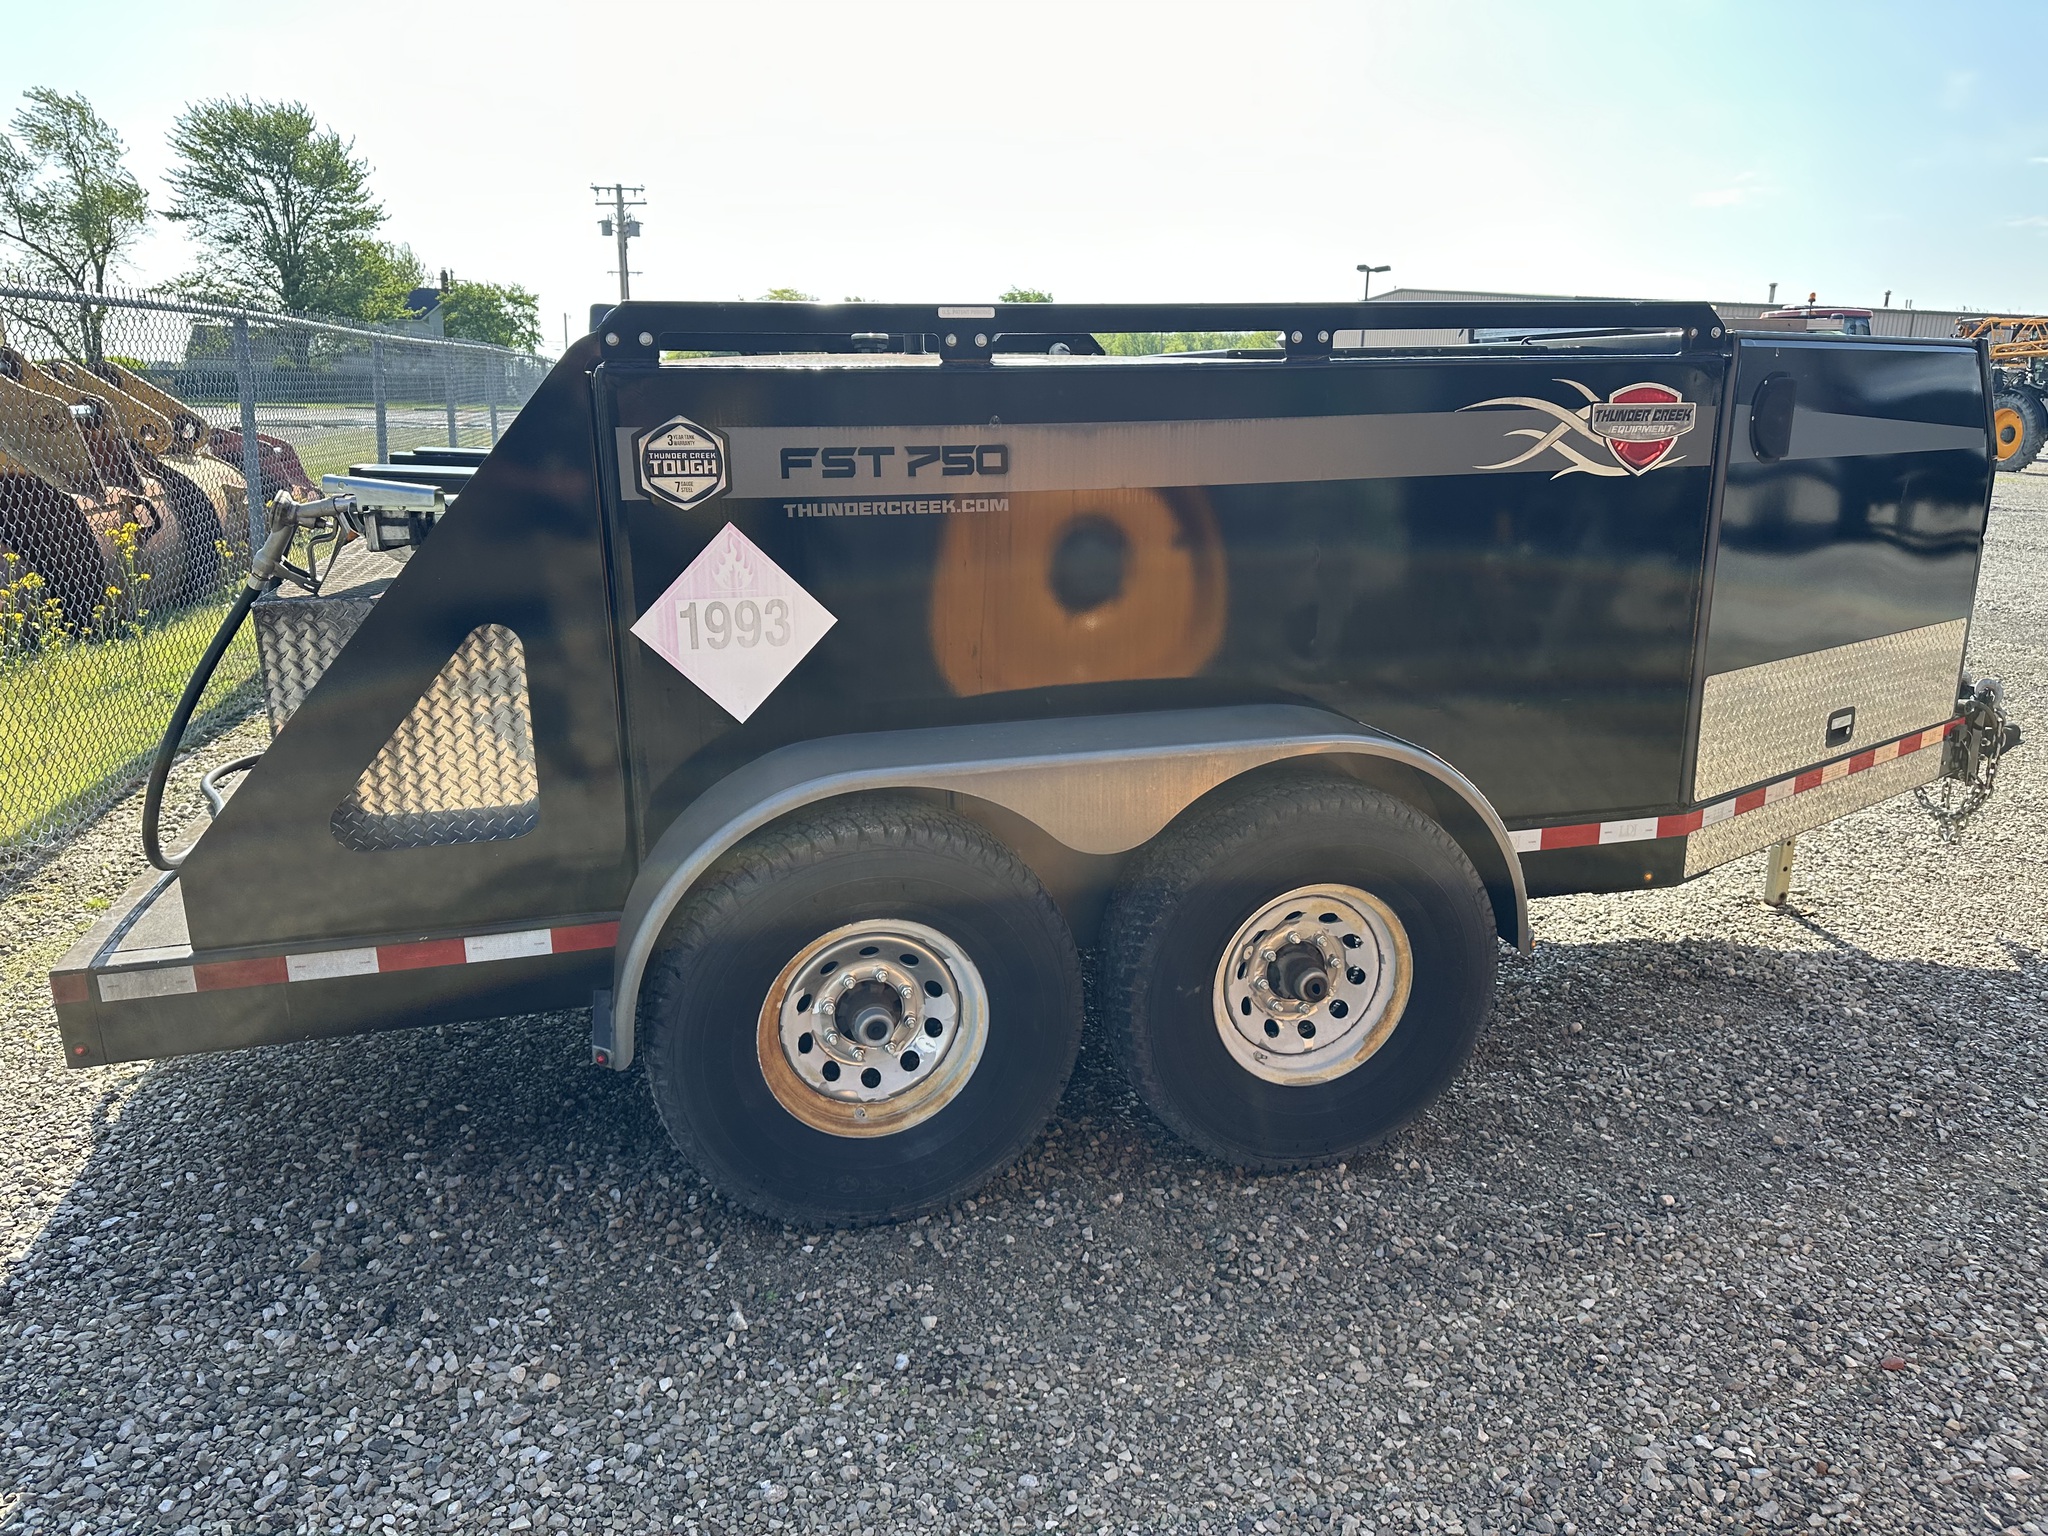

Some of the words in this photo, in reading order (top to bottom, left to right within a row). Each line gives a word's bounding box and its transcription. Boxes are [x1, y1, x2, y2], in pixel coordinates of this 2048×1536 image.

[1595, 409, 1653, 422] THUNDER
[1652, 408, 1693, 422] CREEK
[1610, 424, 1674, 434] EQUIPMENT
[667, 434, 674, 446] 3
[649, 459, 717, 475] TOUGH
[780, 446, 895, 479] FST
[904, 444, 1009, 477] 750
[674, 481, 680, 492] 7
[783, 498, 1009, 518] THUNDERCREEK.COM
[679, 598, 791, 650] 1993
